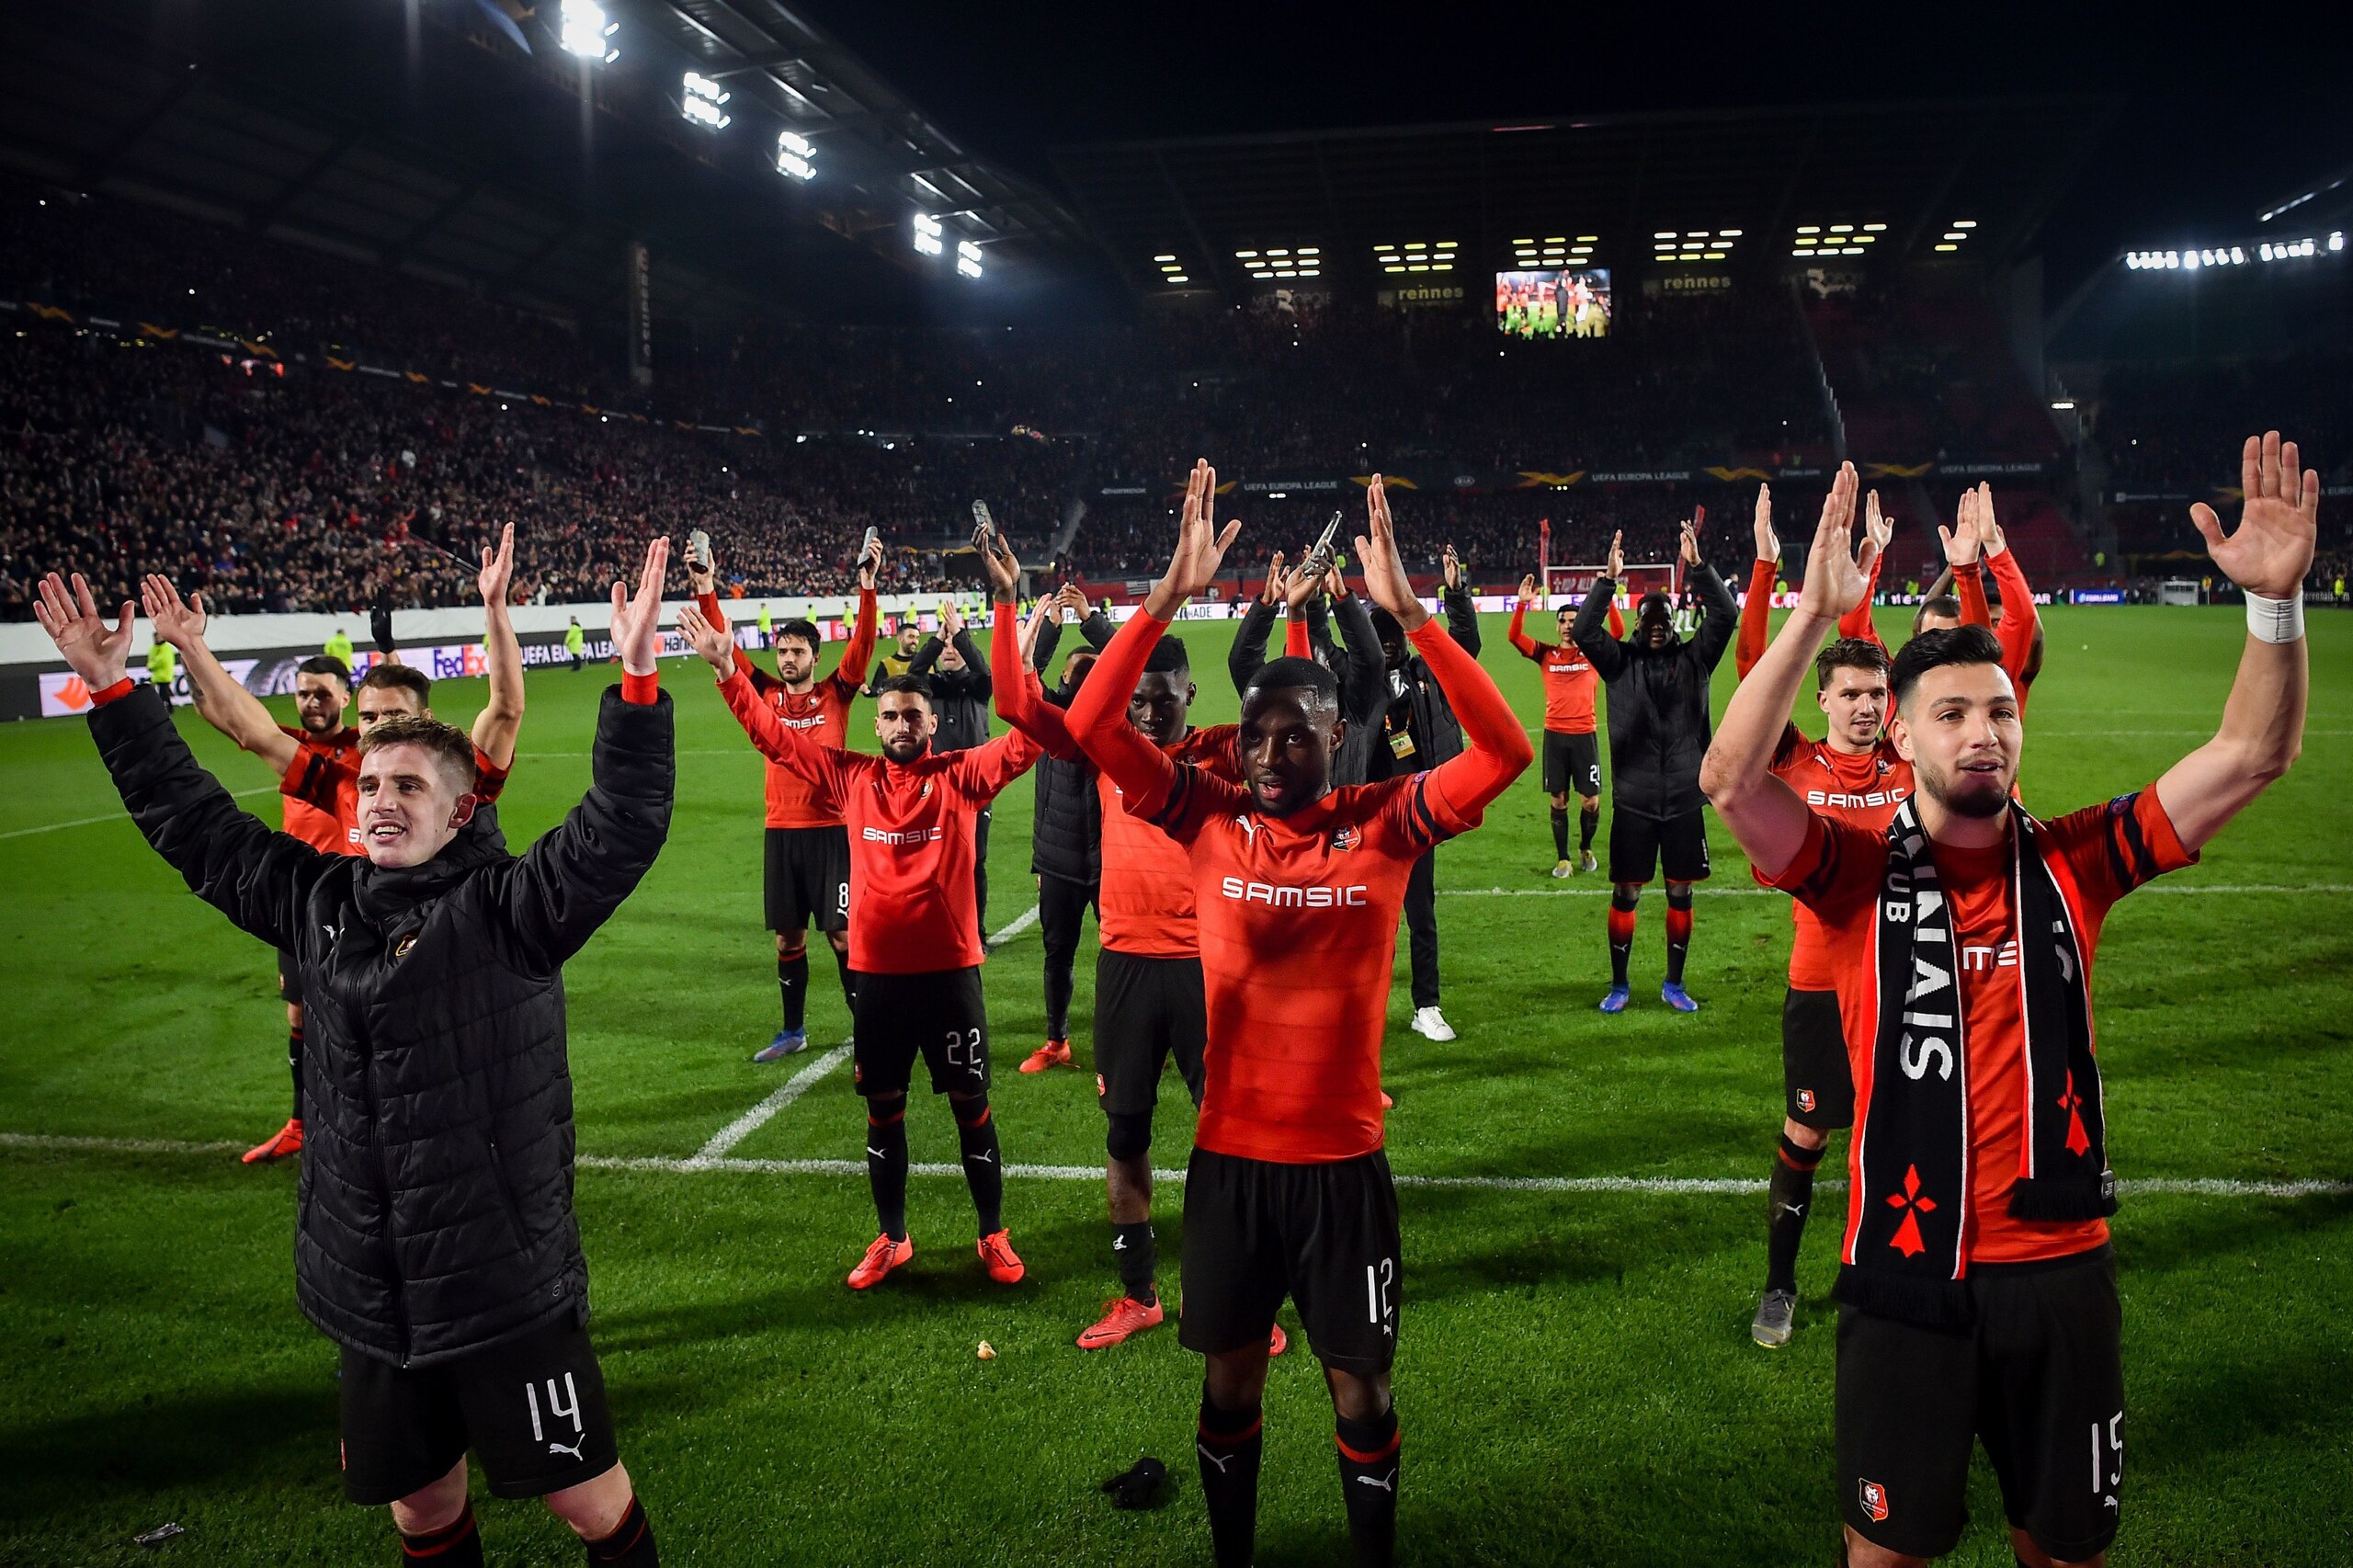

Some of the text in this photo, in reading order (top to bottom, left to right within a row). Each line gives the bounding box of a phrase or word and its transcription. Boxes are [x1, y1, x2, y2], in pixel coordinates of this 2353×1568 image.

[1398, 285, 1464, 301] rennes
[1664, 275, 1732, 290] rennes
[1268, 482, 1302, 491] EUROPA
[1303, 481, 1338, 490] LEAGUE
[1593, 471, 1689, 482] UEFA EUROPA LEAGUE
[434, 642, 488, 679] FedEx
[520, 644, 551, 665] UEFA
[551, 641, 595, 663] EURPA
[1549, 662, 1590, 673] SAMSIC
[1807, 787, 1905, 809] SAMSIC
[862, 825, 943, 846] SAMSIC
[838, 882, 850, 909] 8
[1222, 876, 1368, 907] SAMSIC
[946, 1028, 982, 1065] 22
[1367, 1257, 1393, 1324] 12
[526, 1371, 583, 1441] 14
[2091, 1410, 2123, 1494] 15
